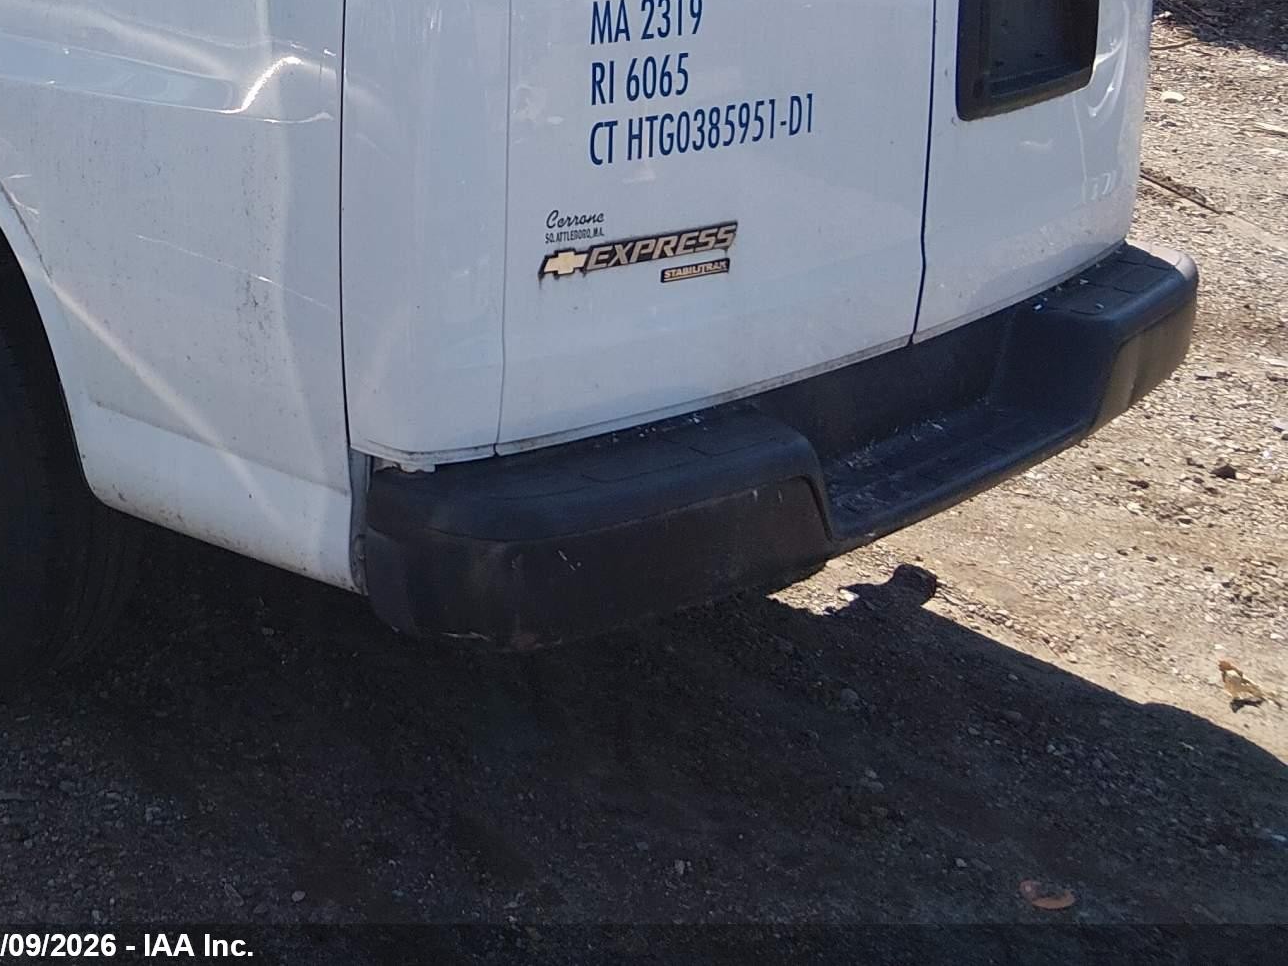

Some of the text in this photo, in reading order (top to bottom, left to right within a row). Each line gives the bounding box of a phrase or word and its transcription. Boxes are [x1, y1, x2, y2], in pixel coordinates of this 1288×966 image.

[591, 52, 689, 106] RI 6065
[589, 92, 813, 166] CT HTG0385951-D1
[545, 209, 605, 229] Cerrone
[585, 223, 738, 272] EXPRESS
